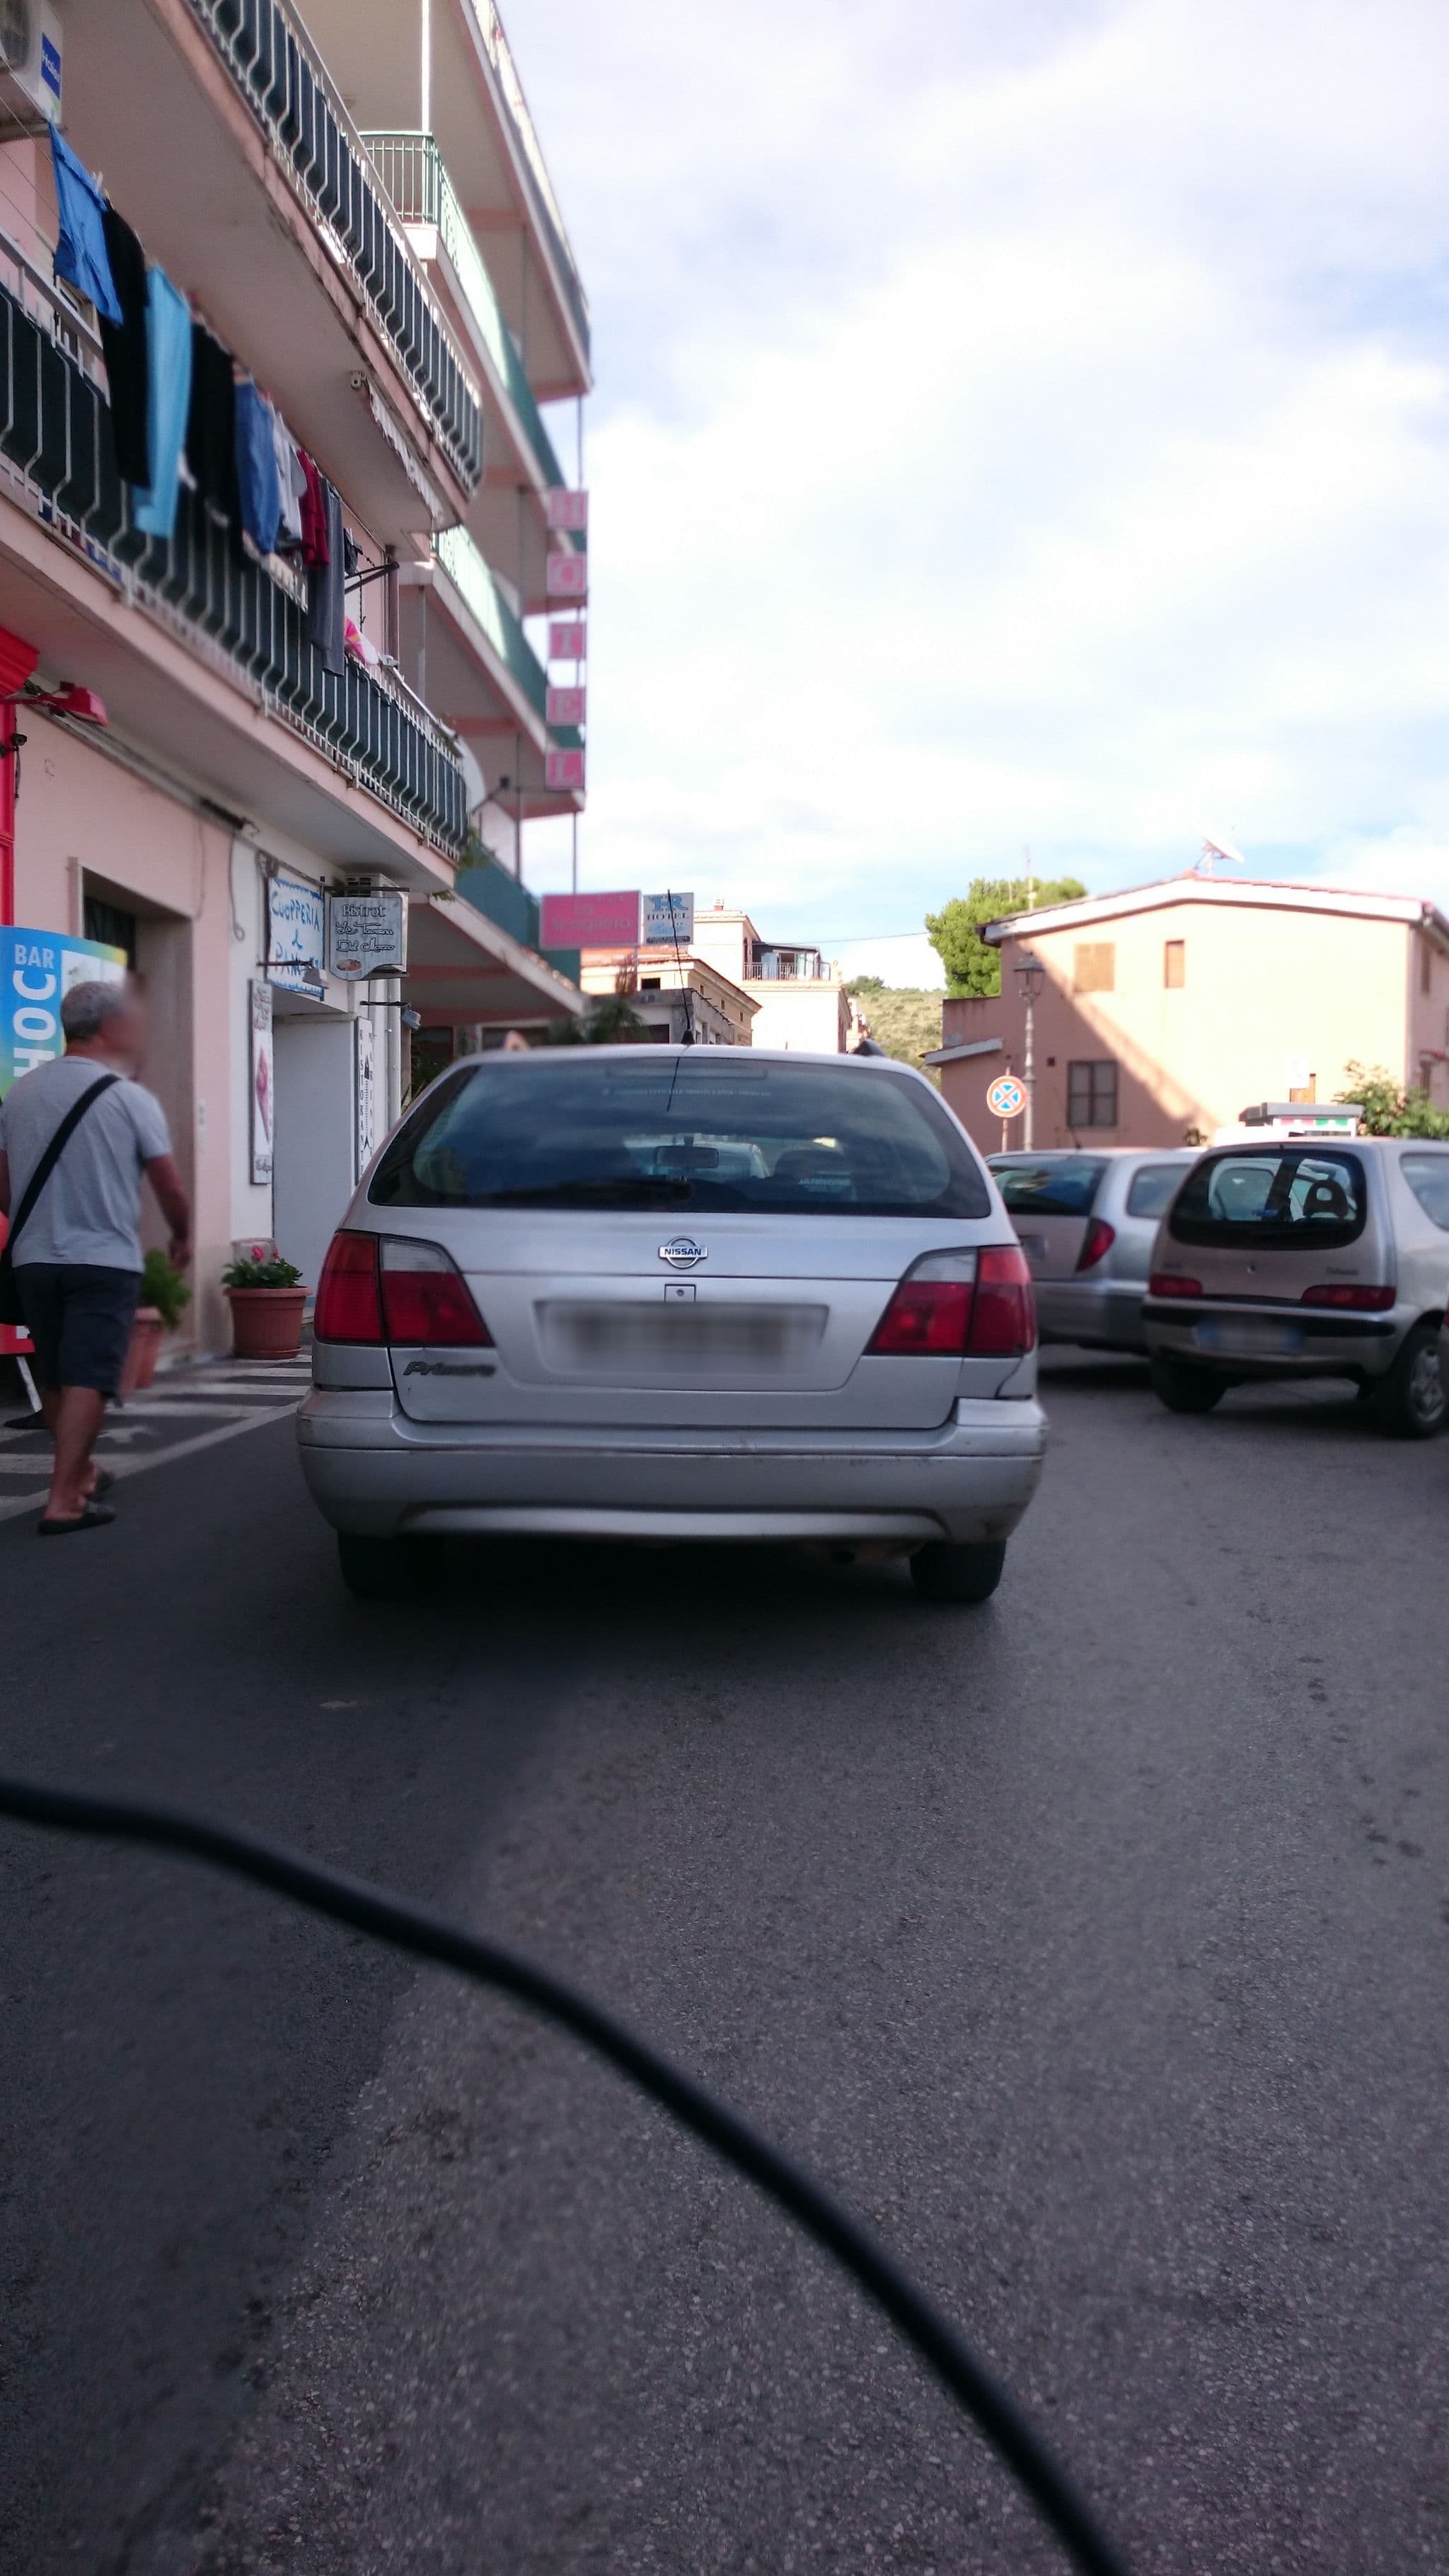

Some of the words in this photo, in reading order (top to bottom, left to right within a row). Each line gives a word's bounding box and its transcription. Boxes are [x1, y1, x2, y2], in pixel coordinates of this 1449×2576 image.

[342, 904, 386, 917] Bistrot
[647, 912, 690, 921] HOTEL
[336, 939, 359, 952] Del
[14, 944, 54, 969] BAR
